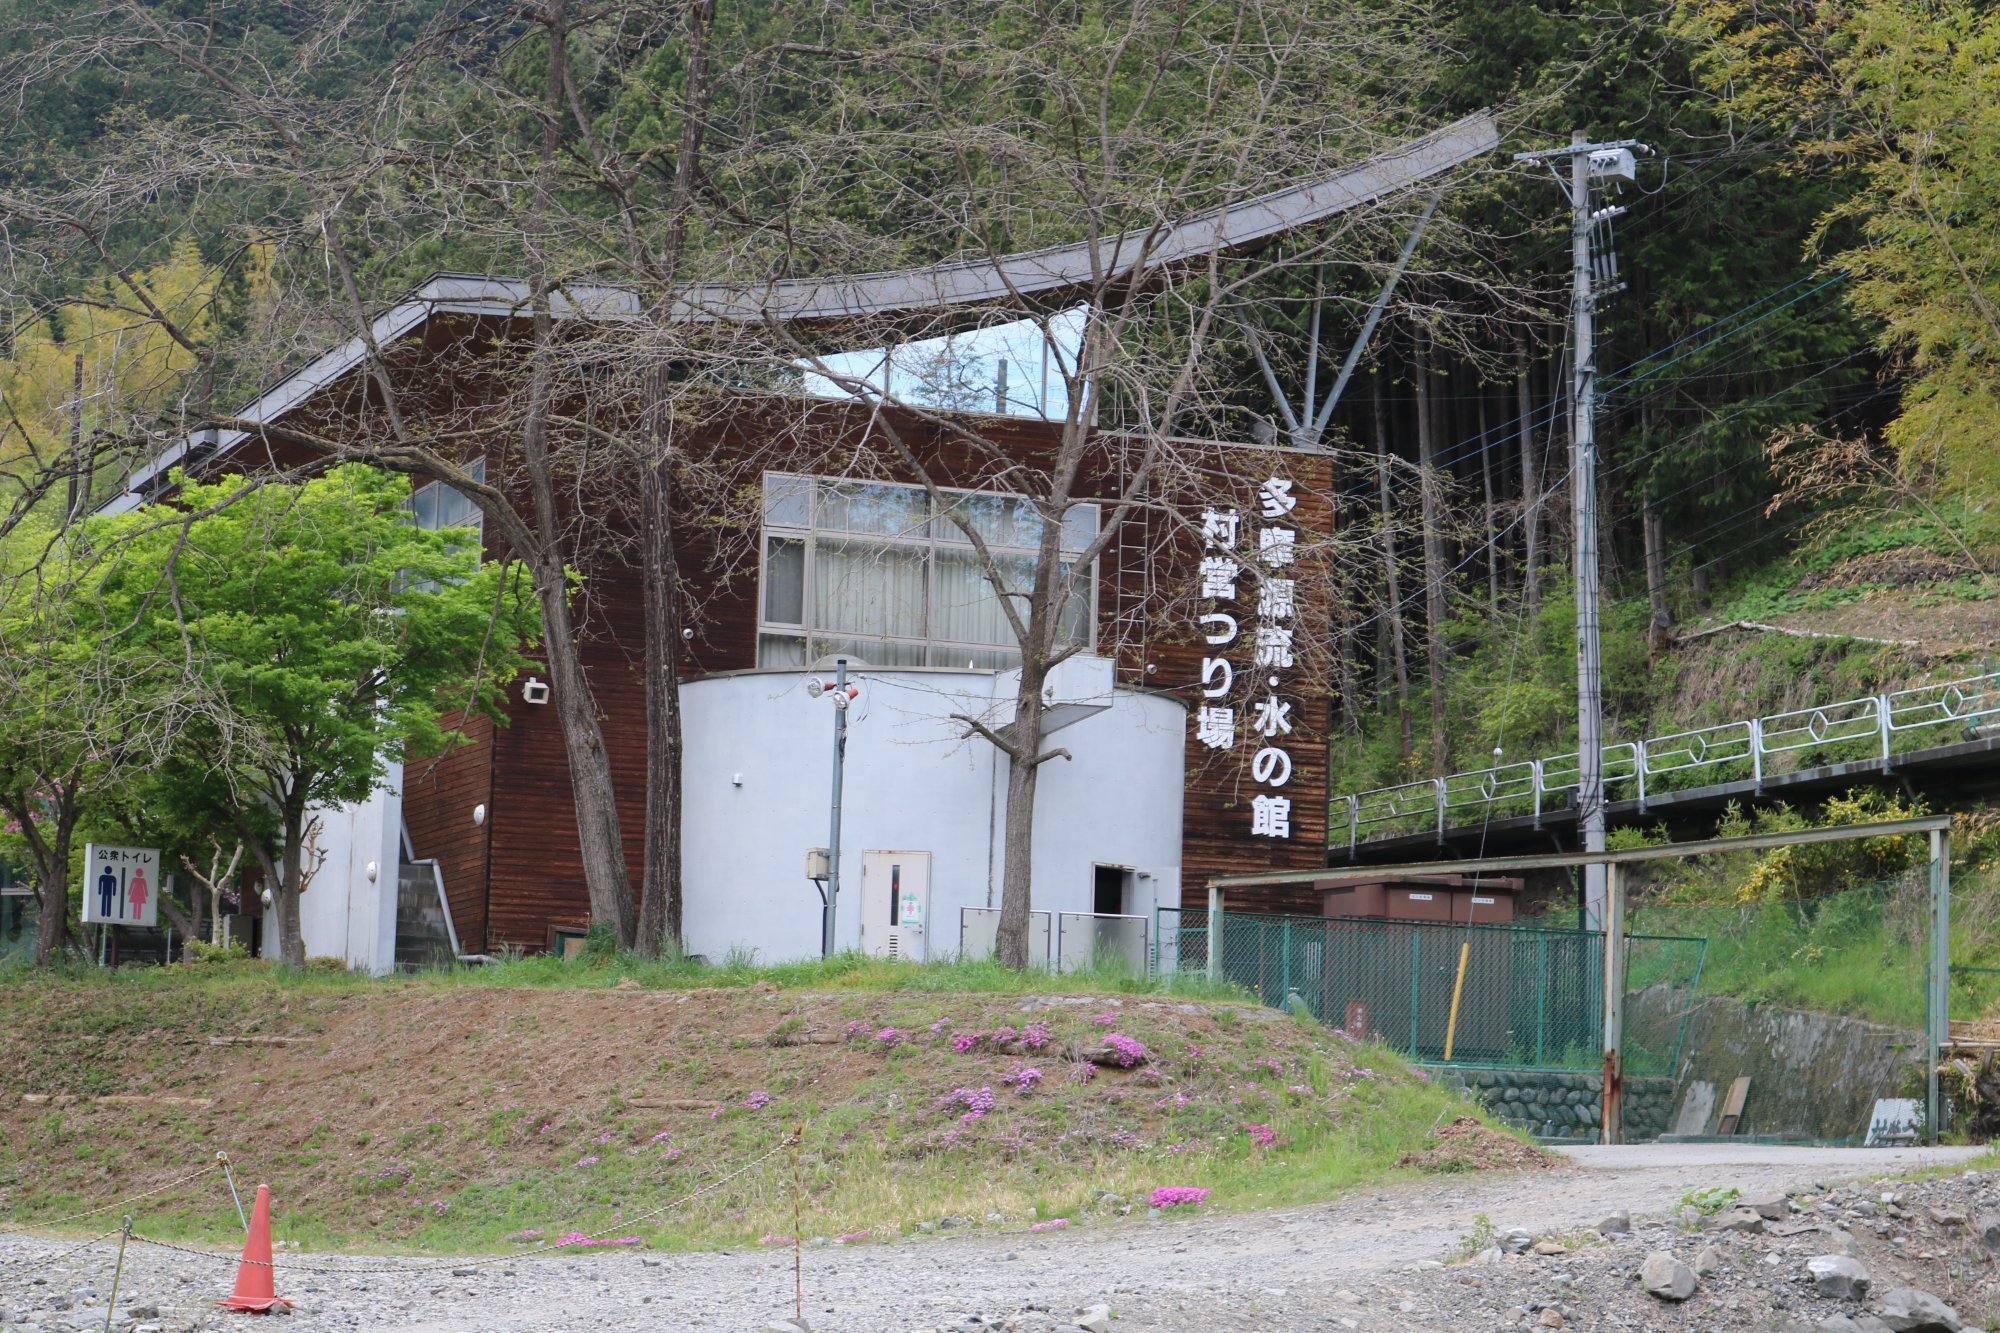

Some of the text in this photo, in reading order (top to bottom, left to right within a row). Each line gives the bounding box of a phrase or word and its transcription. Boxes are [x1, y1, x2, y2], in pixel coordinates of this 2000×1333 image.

[1196, 507, 1239, 750] 村営つり場
[98, 849, 152, 863] 公衆トイレ
